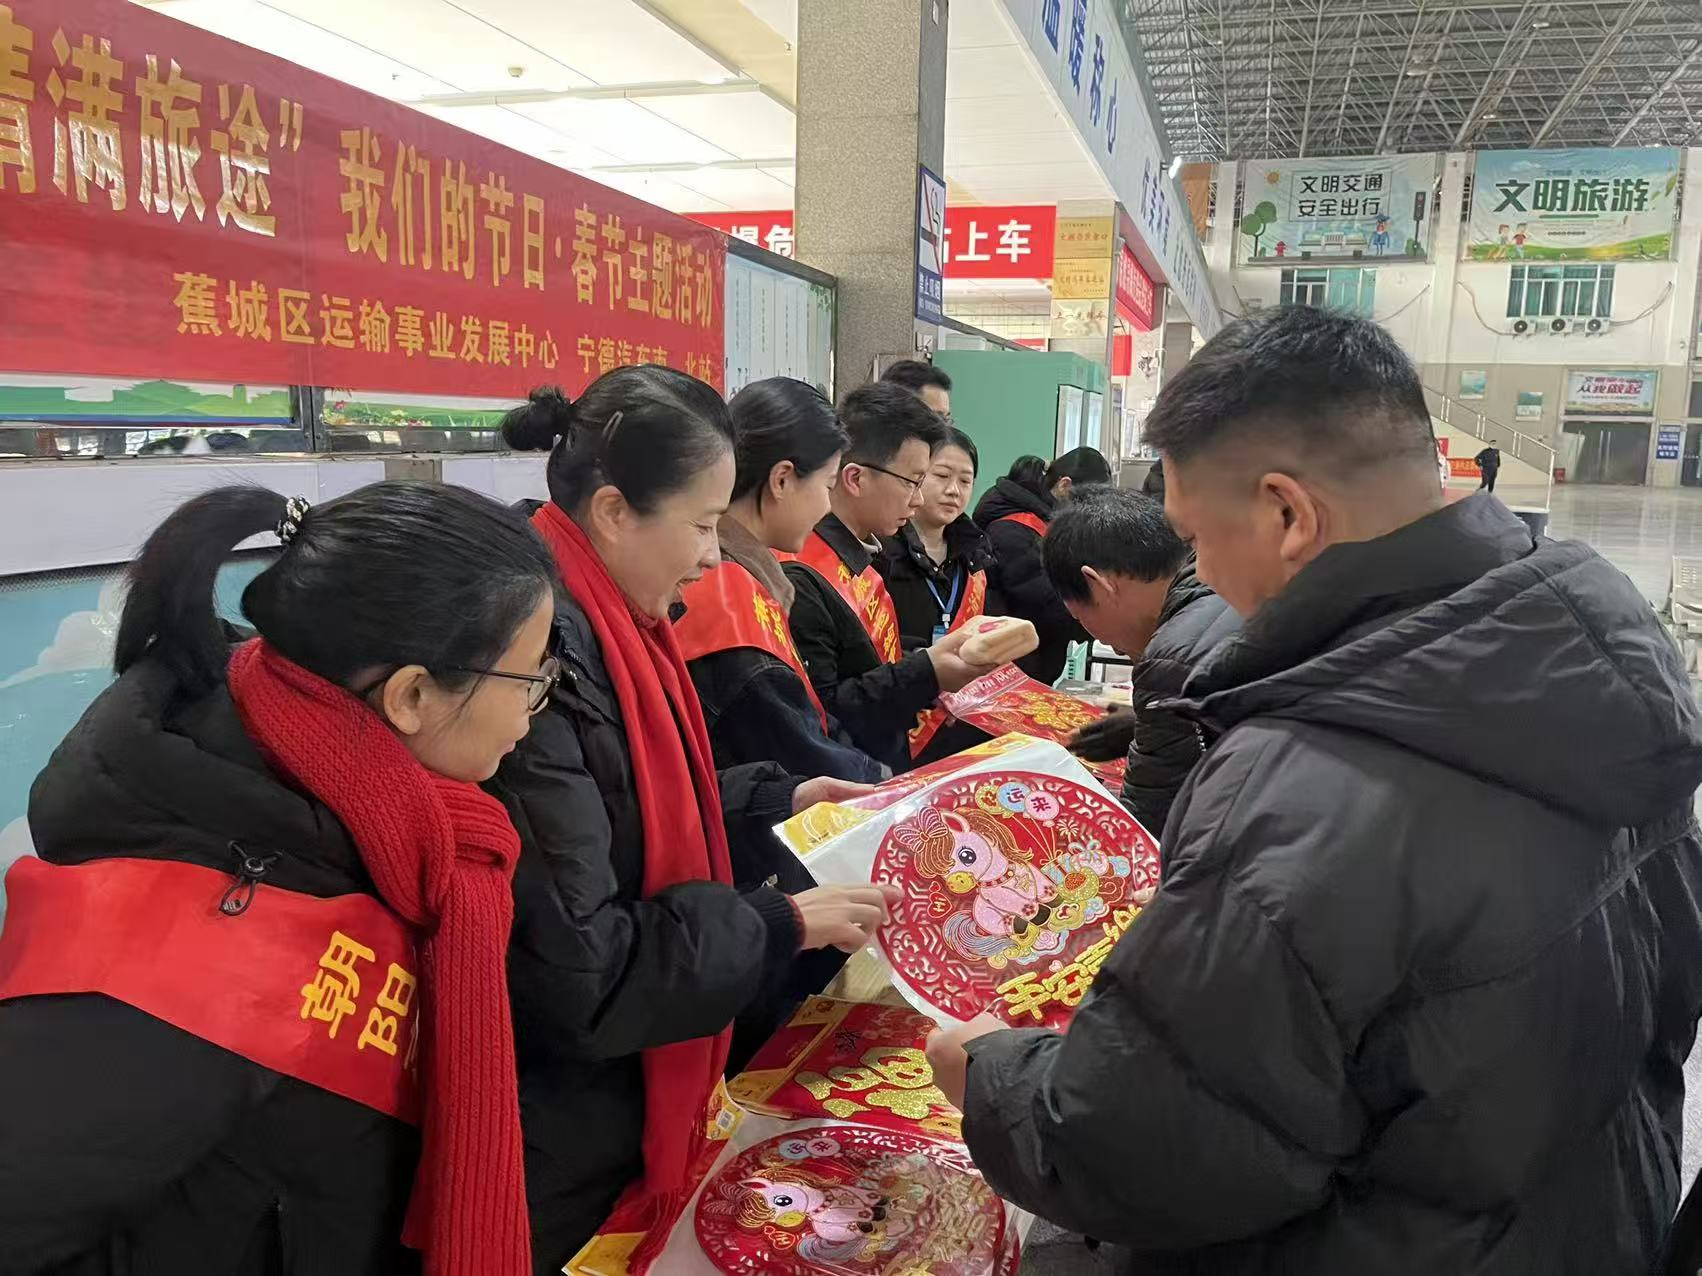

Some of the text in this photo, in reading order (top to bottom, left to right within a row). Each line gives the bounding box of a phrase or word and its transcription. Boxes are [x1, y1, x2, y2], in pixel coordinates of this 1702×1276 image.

[1300, 173, 1384, 194] 文明交通
[1493, 178, 1651, 213] 文明旅游
[1298, 197, 1381, 218] 安全出行
[943, 219, 1032, 263] 上车
[172, 271, 559, 369] 蕉城区运输事业发展中心
